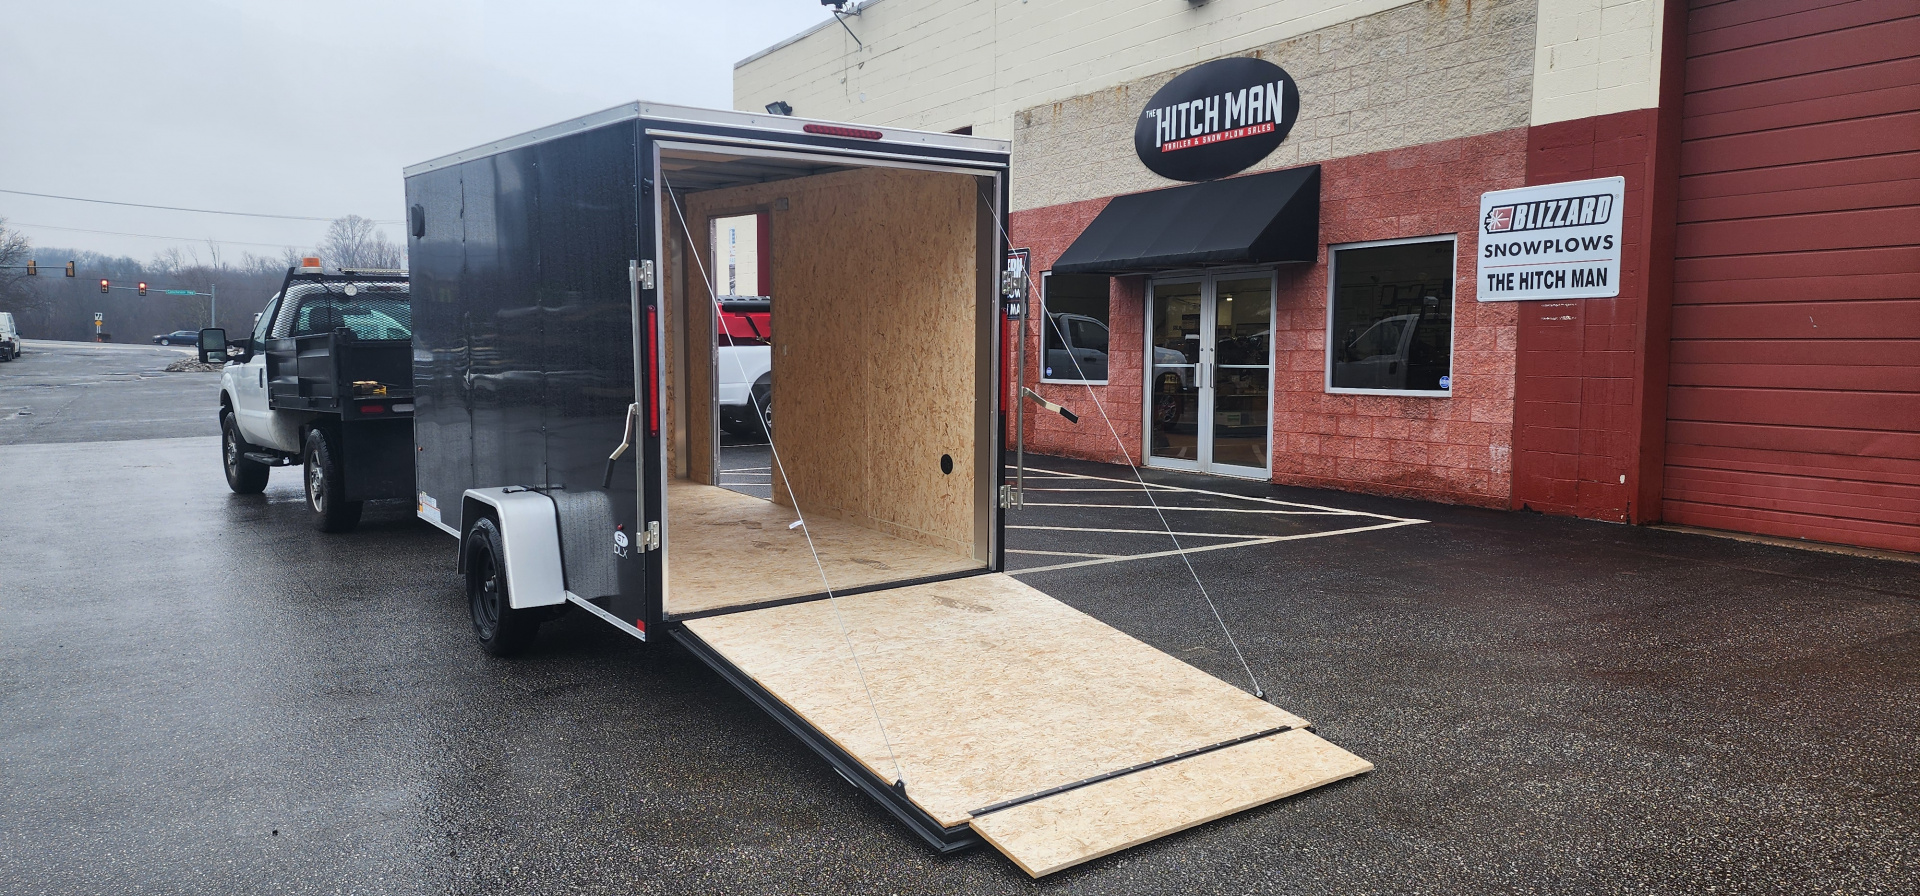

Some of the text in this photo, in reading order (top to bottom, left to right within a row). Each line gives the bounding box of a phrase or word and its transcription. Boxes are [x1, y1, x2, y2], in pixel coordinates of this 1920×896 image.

[1146, 80, 1284, 147] THE HITCH MAN
[1164, 139, 1191, 151] TRAILER
[1202, 133, 1221, 144] SNOW
[1225, 128, 1244, 139] PLOW
[1247, 123, 1271, 135] SALES
[1513, 195, 1611, 230] BLIZZARD
[1484, 235, 1613, 258] SNOWPLOWS
[1487, 267, 1608, 291] THE HITCH MAN
[613, 543, 628, 559] DLX
